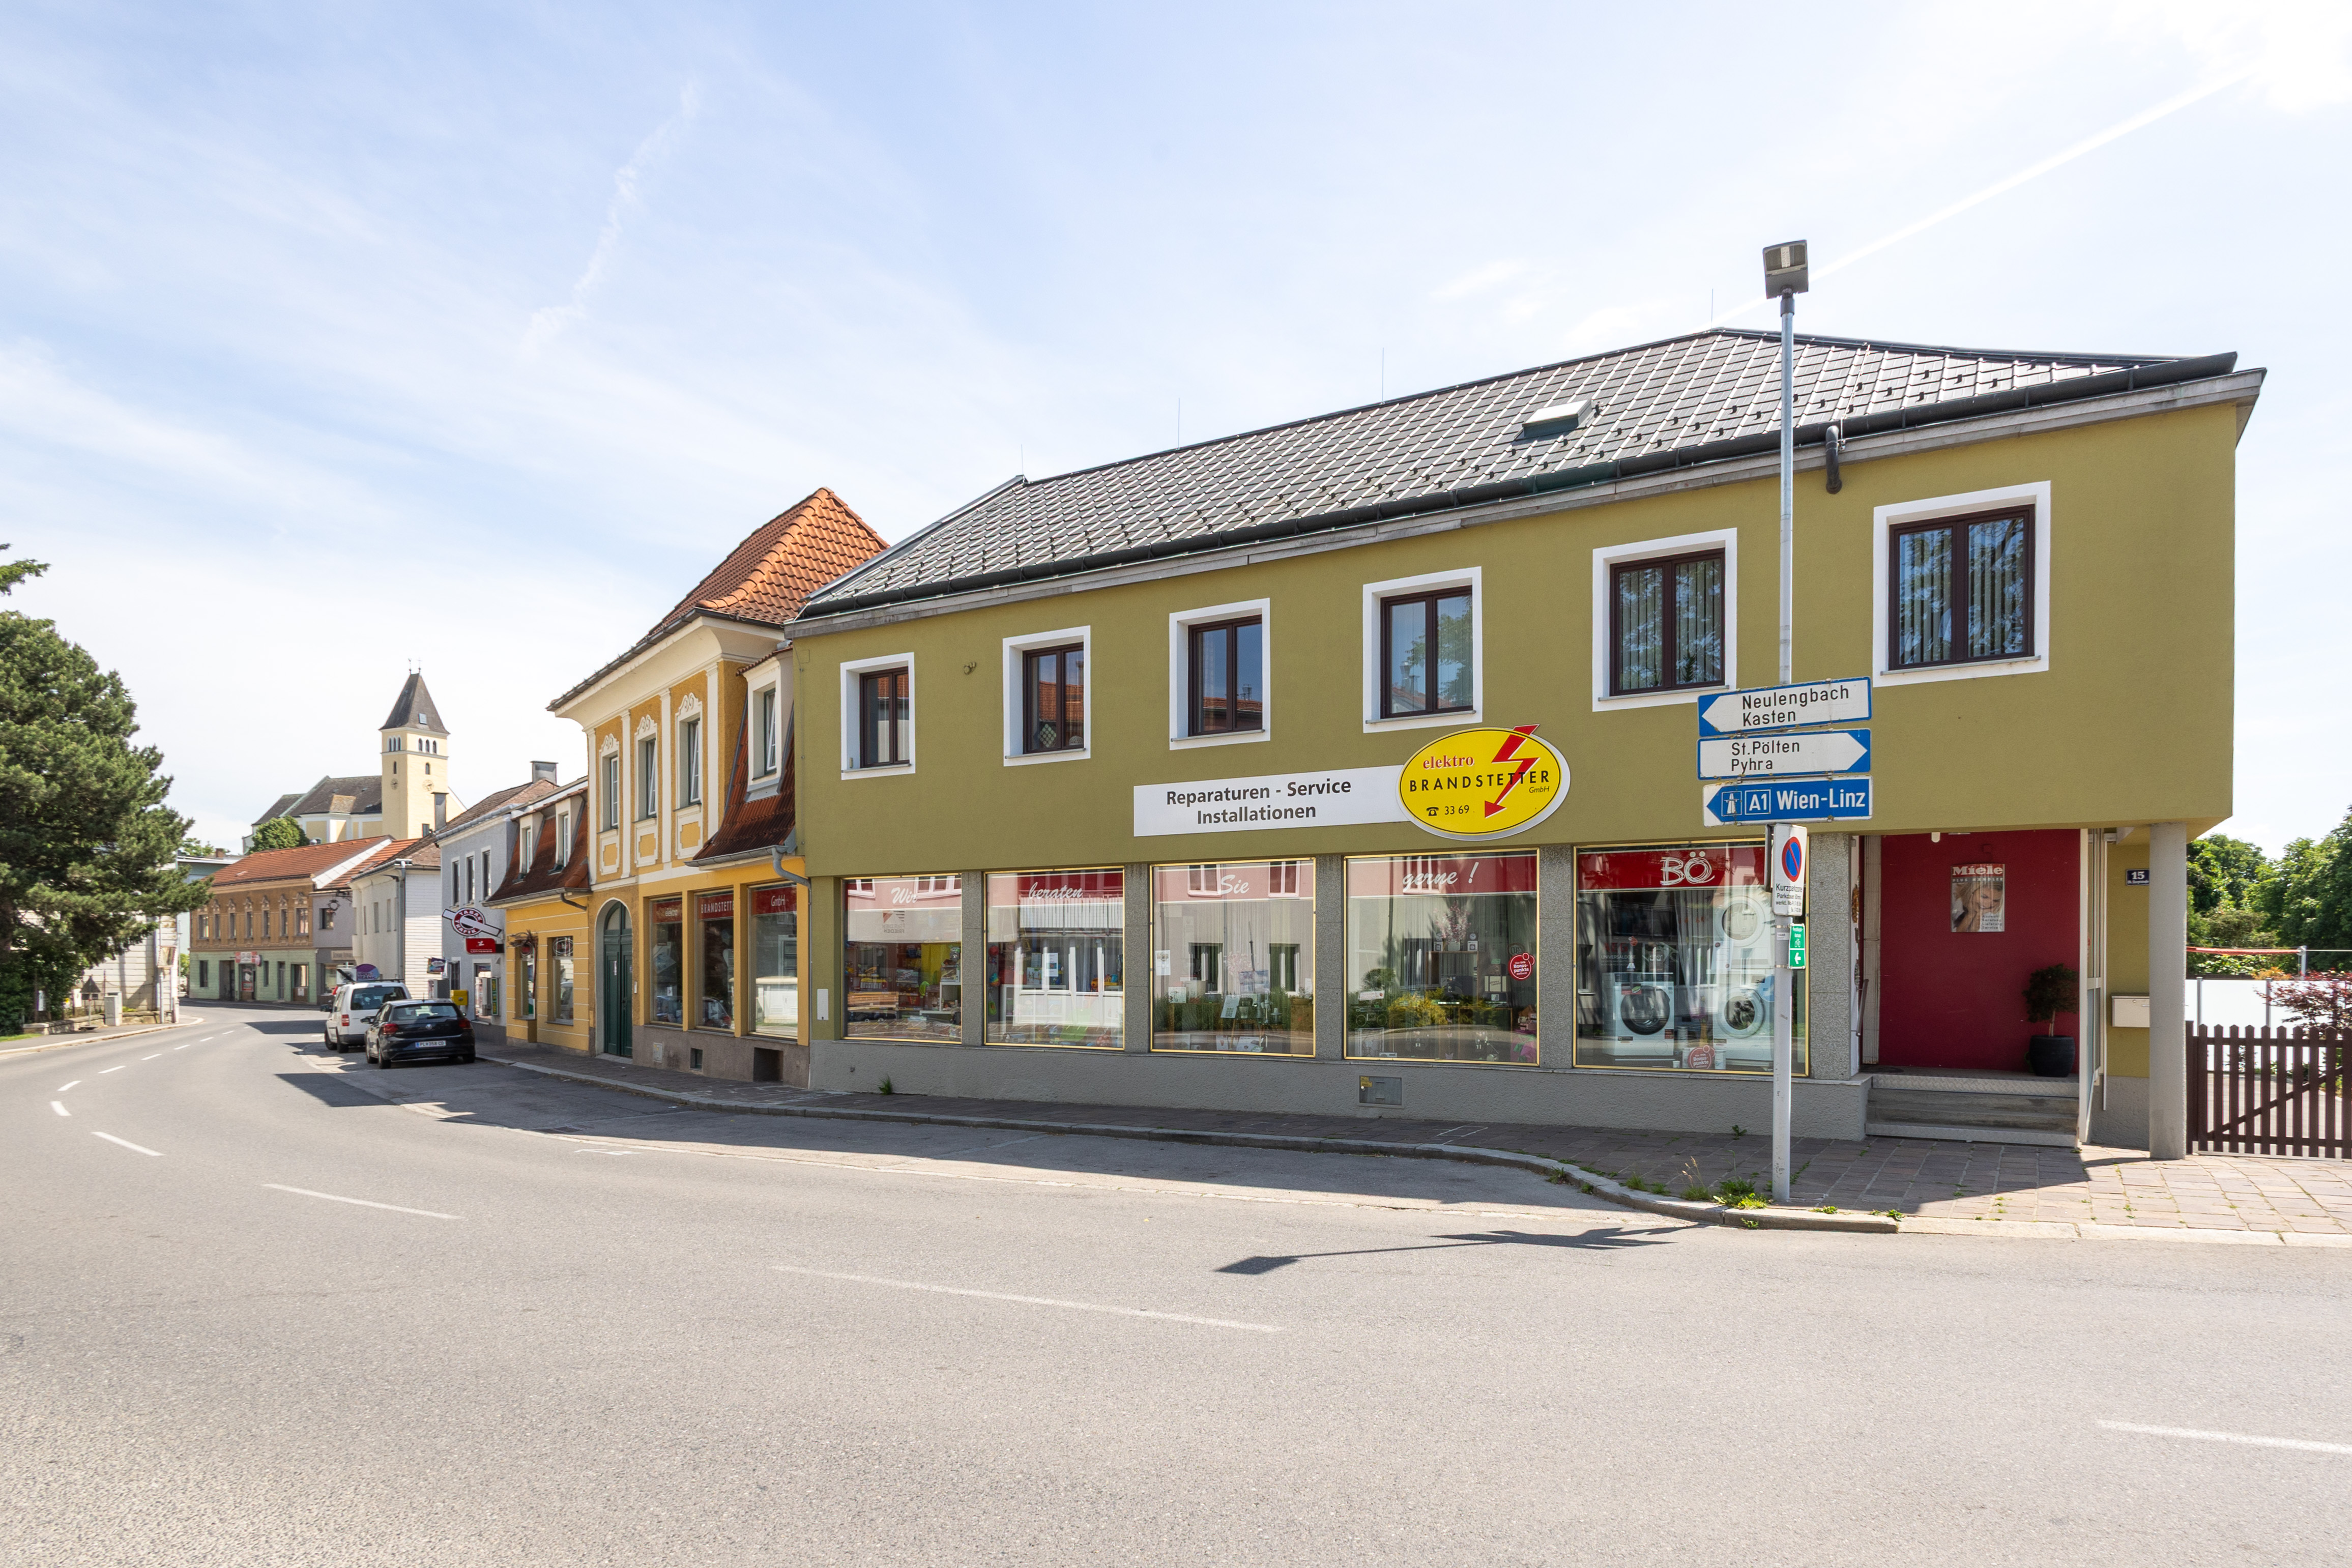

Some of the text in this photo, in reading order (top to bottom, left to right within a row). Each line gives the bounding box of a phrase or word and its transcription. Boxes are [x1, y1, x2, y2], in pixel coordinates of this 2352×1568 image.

[1742, 685, 1849, 710] Neulengbach
[1743, 709, 1796, 727] Kasten
[1423, 754, 1475, 770] elektro
[1731, 758, 1773, 774] Pyhra
[1409, 770, 1550, 792] BRANDSTETTER
[1166, 785, 1270, 808] Reparaturen
[1287, 778, 1351, 797] Service
[1529, 785, 1550, 795] GmbH
[1749, 788, 1866, 811] A1 Wien-Linz
[1197, 804, 1317, 825] Installationen
[1444, 804, 1470, 815] 33 69
[1660, 851, 1715, 885] BÖ
[1952, 865, 2003, 876] Miele
[2131, 871, 2145, 880] 15
[1028, 882, 1083, 900] beraten
[1217, 874, 1250, 895] Sie
[1402, 872, 1458, 893] gerne
[771, 894, 786, 907] GmbH
[891, 887, 918, 904] Wir
[459, 910, 483, 921] TABAK
[454, 919, 477, 934] TRAFIK
